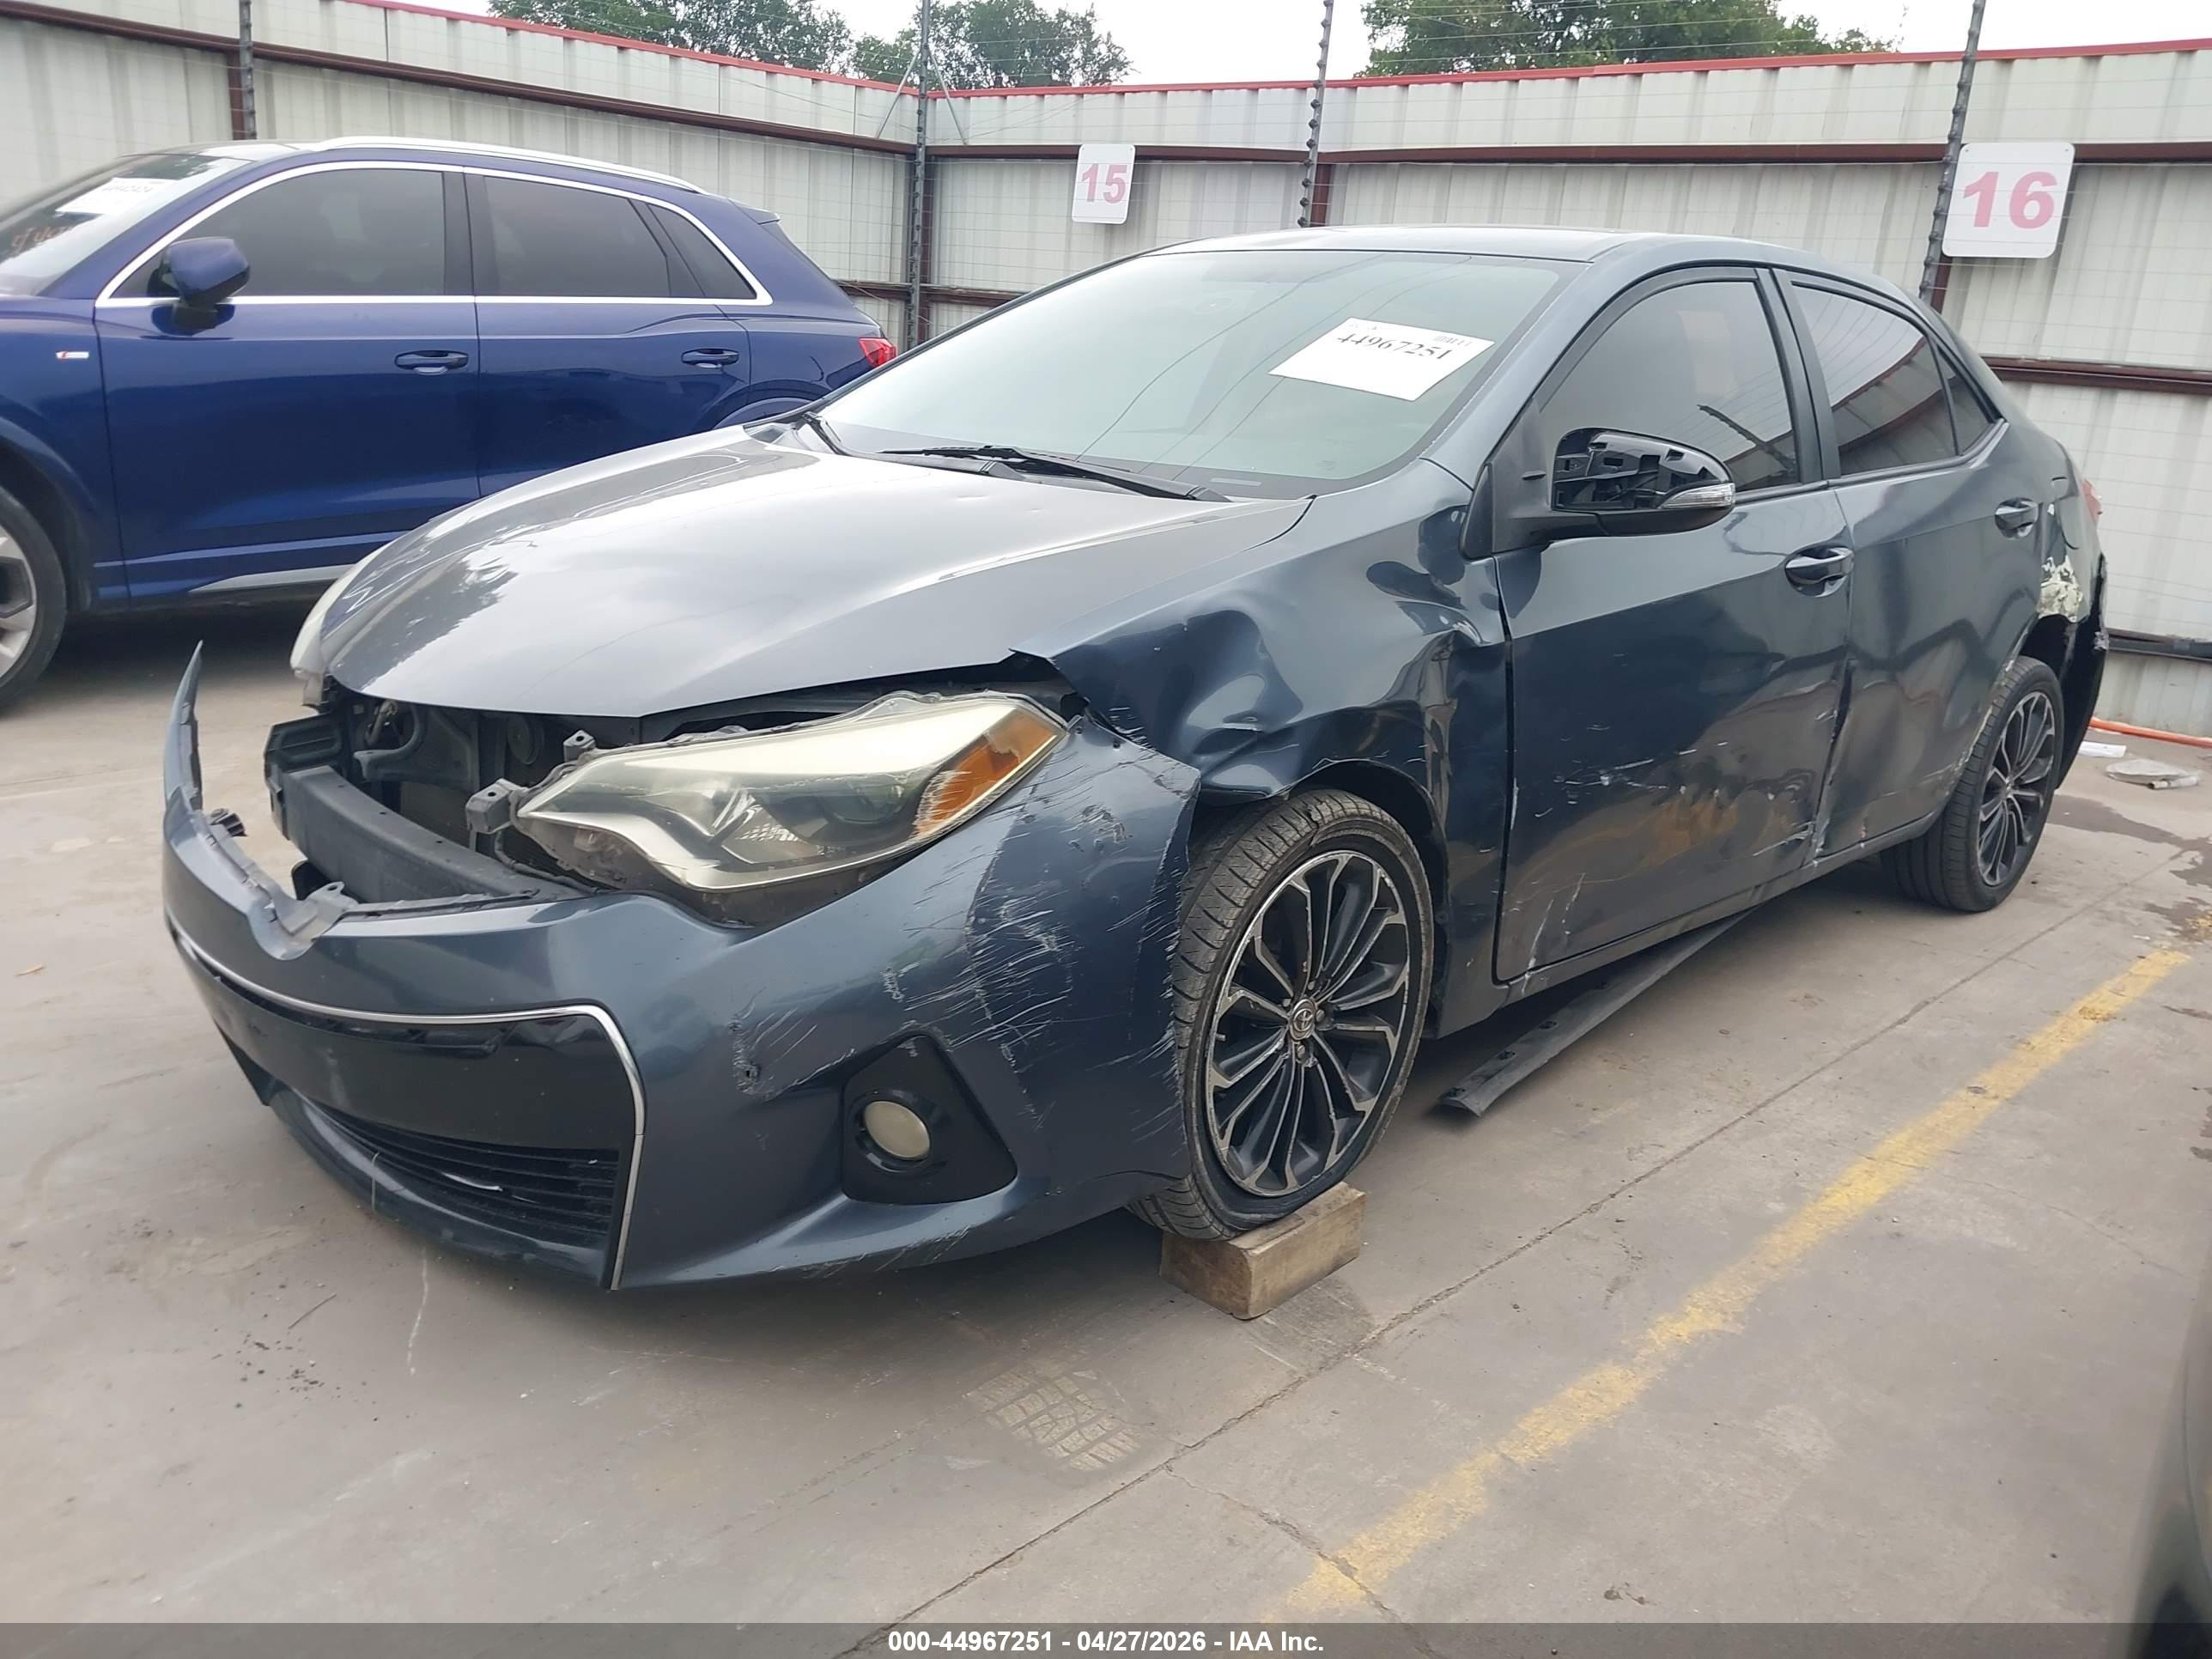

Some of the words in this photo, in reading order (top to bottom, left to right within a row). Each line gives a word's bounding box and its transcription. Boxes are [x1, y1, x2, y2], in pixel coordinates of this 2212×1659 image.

[1081, 163, 1127, 204] 15
[1963, 171, 2058, 229] 16
[1336, 332, 1453, 360] 44967251
